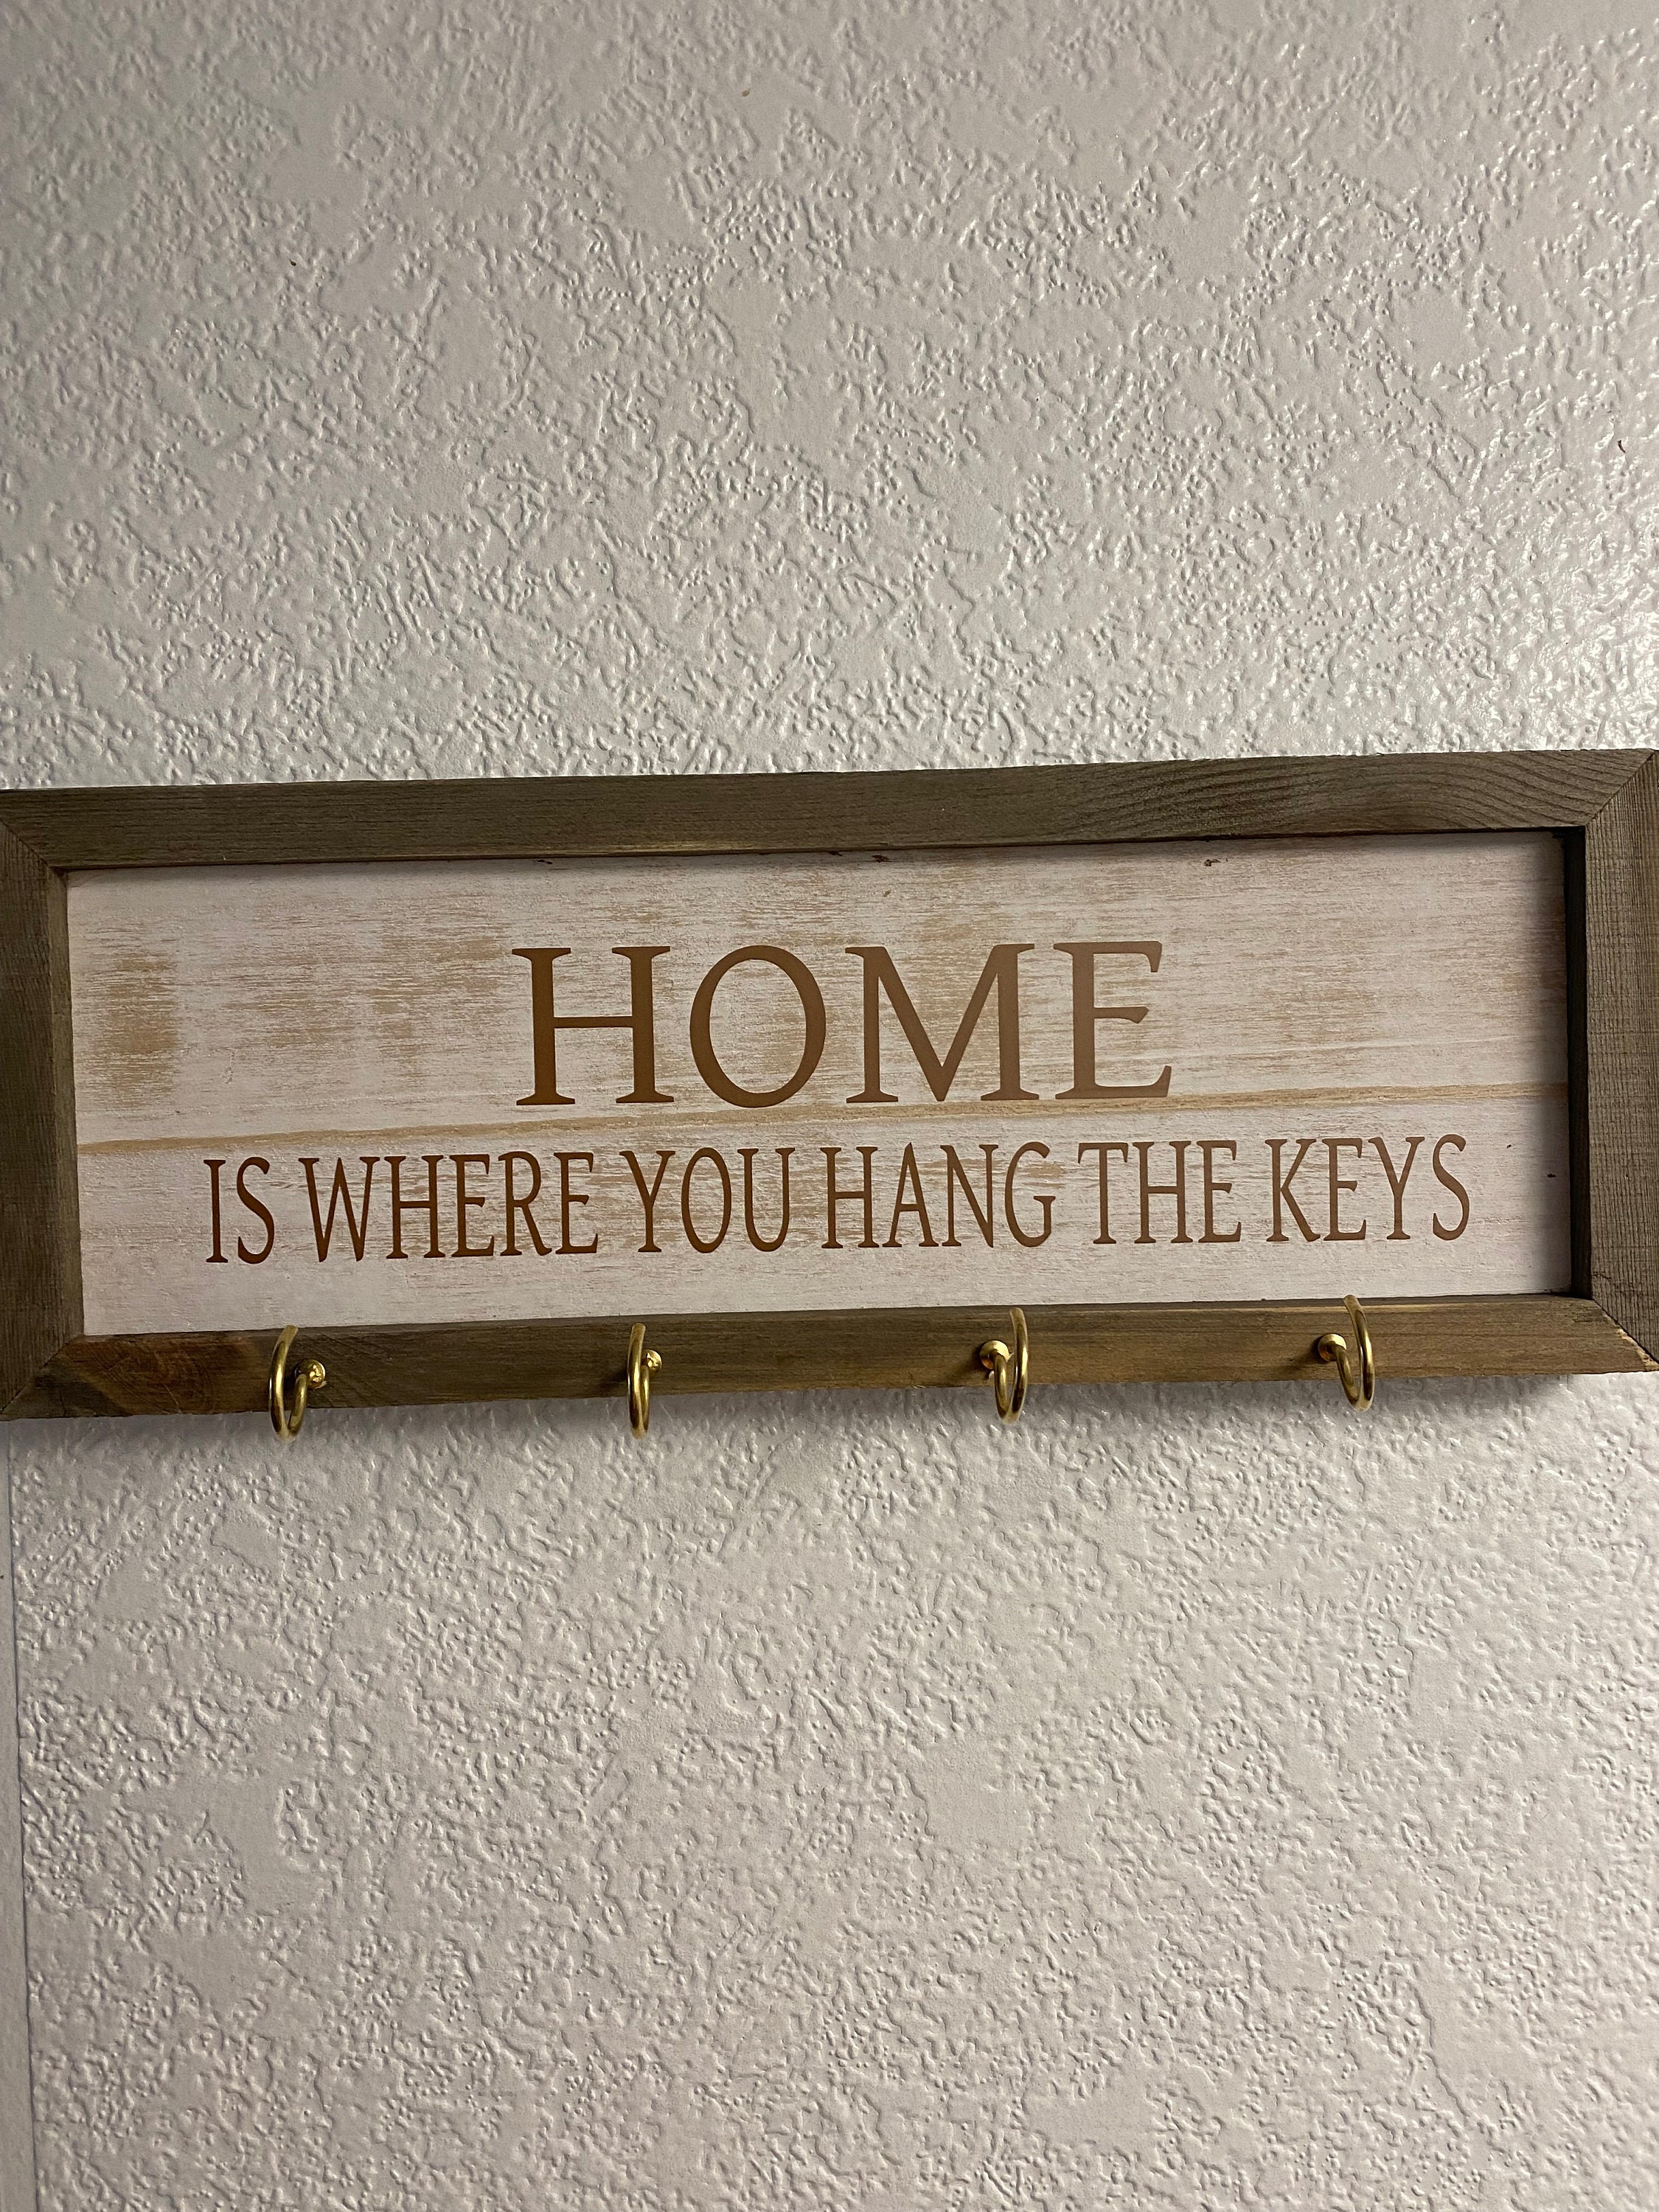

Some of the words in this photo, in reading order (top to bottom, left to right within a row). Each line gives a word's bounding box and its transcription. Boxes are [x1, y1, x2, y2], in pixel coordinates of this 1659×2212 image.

[511, 941, 1172, 1108] HOME
[204, 1156, 275, 1265] IS
[298, 1151, 599, 1262] WHERE
[619, 1147, 797, 1254] YOU
[819, 1141, 1056, 1250] HANG
[1078, 1140, 1242, 1245] THE
[1265, 1133, 1470, 1242] KEYS
